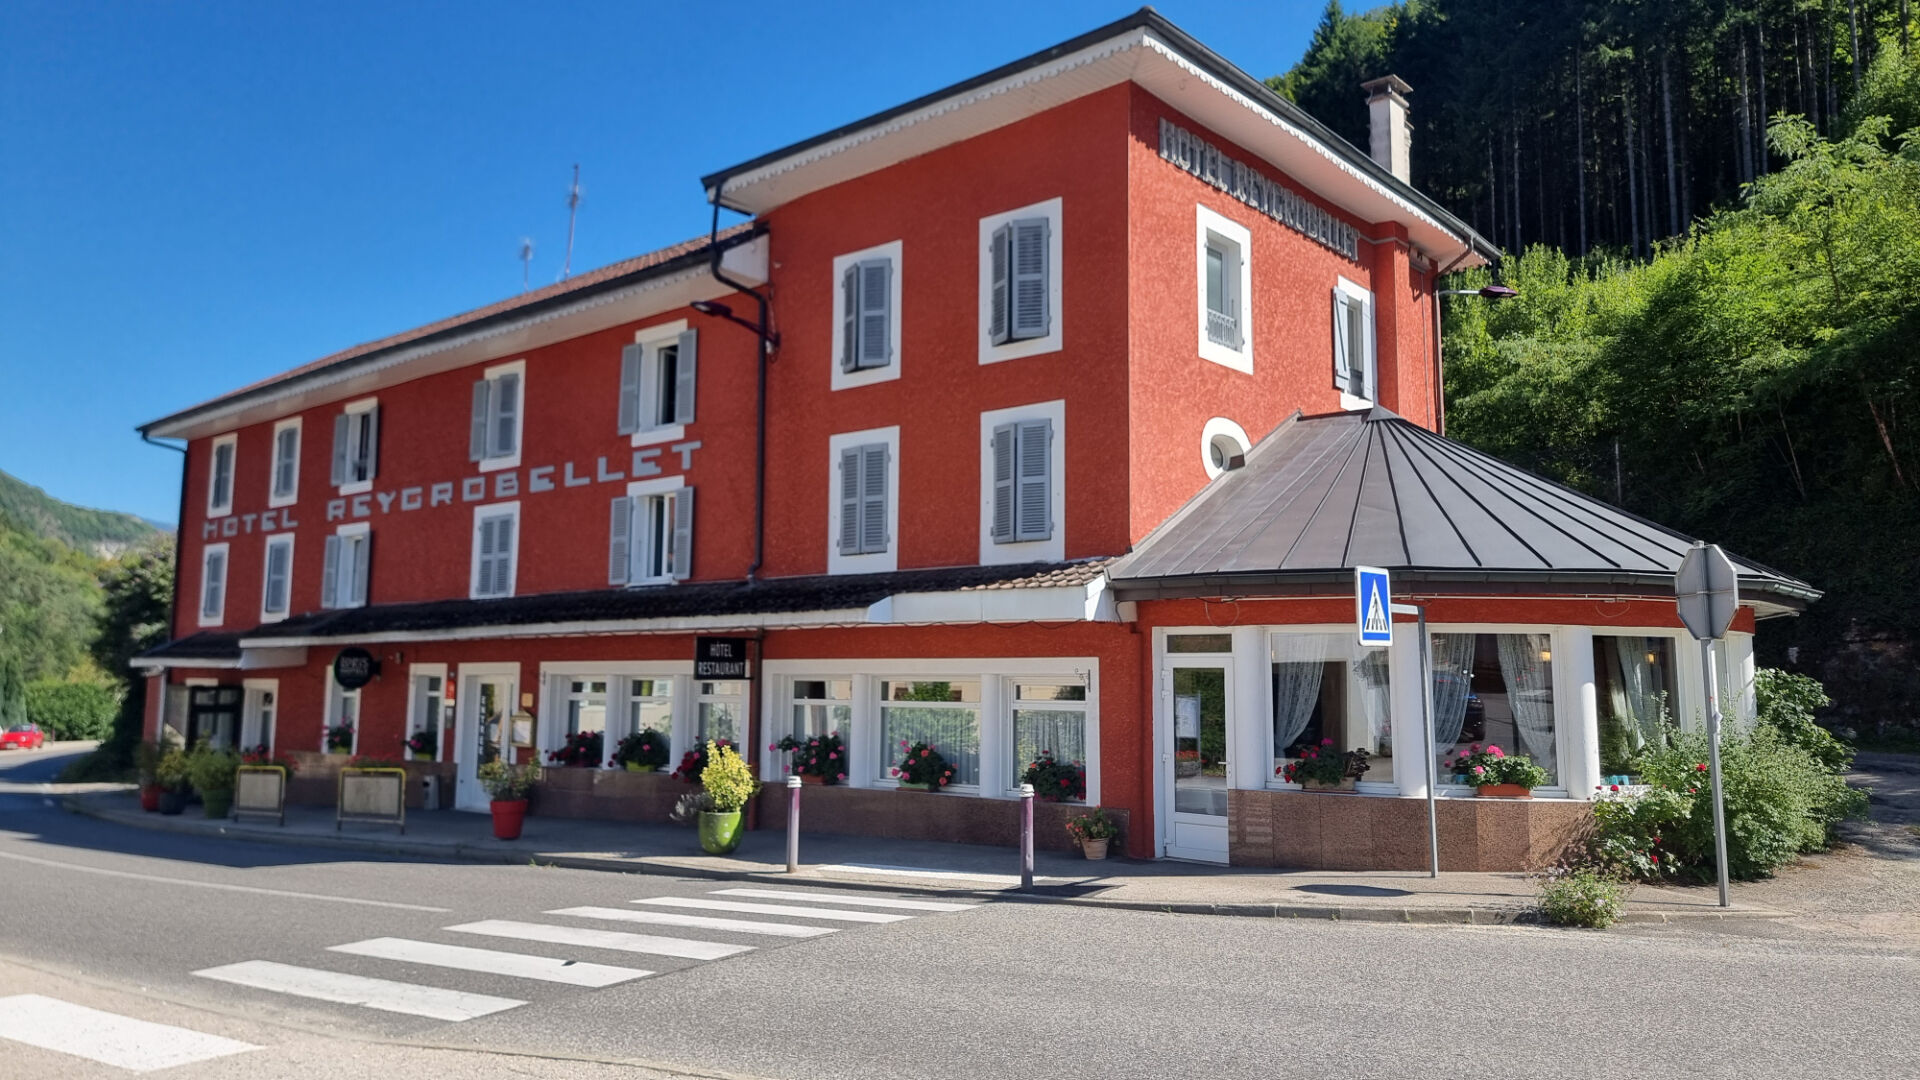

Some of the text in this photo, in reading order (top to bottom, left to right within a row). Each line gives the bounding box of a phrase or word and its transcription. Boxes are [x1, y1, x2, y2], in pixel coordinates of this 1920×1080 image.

[202, 440, 702, 540] HOTEL REYGROBELLET
[698, 661, 745, 676] RESTAURANT
